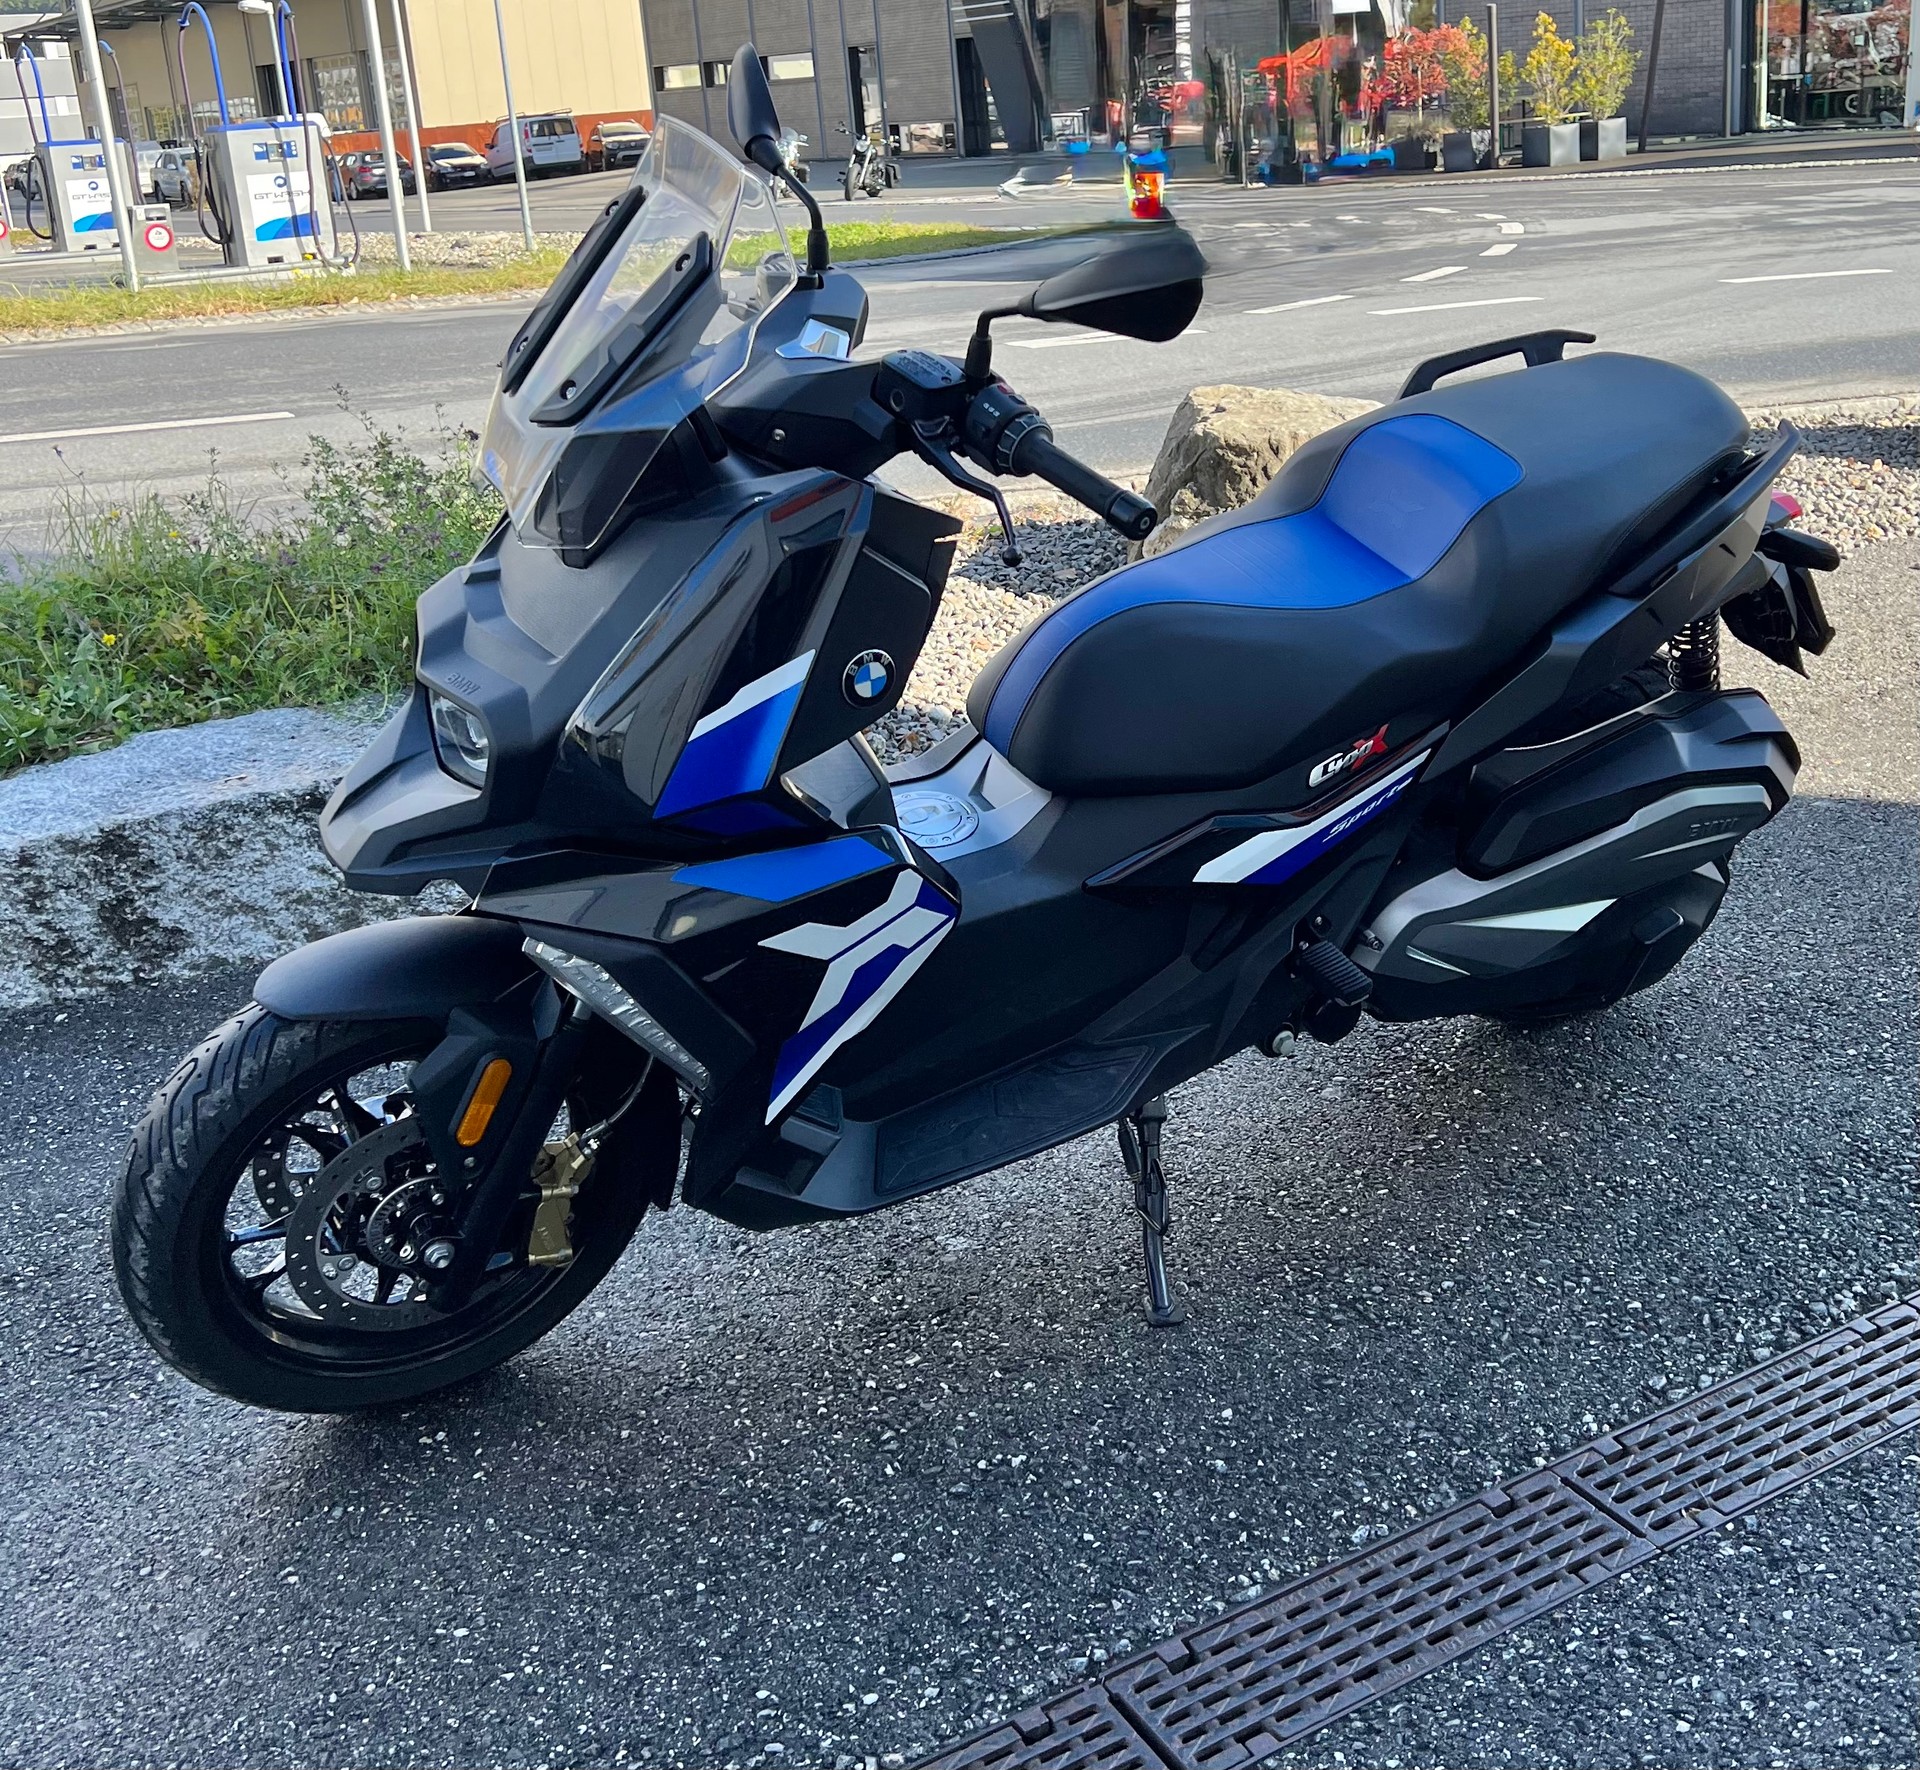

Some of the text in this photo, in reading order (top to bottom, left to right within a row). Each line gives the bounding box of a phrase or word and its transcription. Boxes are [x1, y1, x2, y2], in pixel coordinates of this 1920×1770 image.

[254, 192, 273, 200] GT
[848, 652, 890, 676] BMW
[447, 672, 481, 695] BMW
[1322, 776, 1414, 843] Sport
